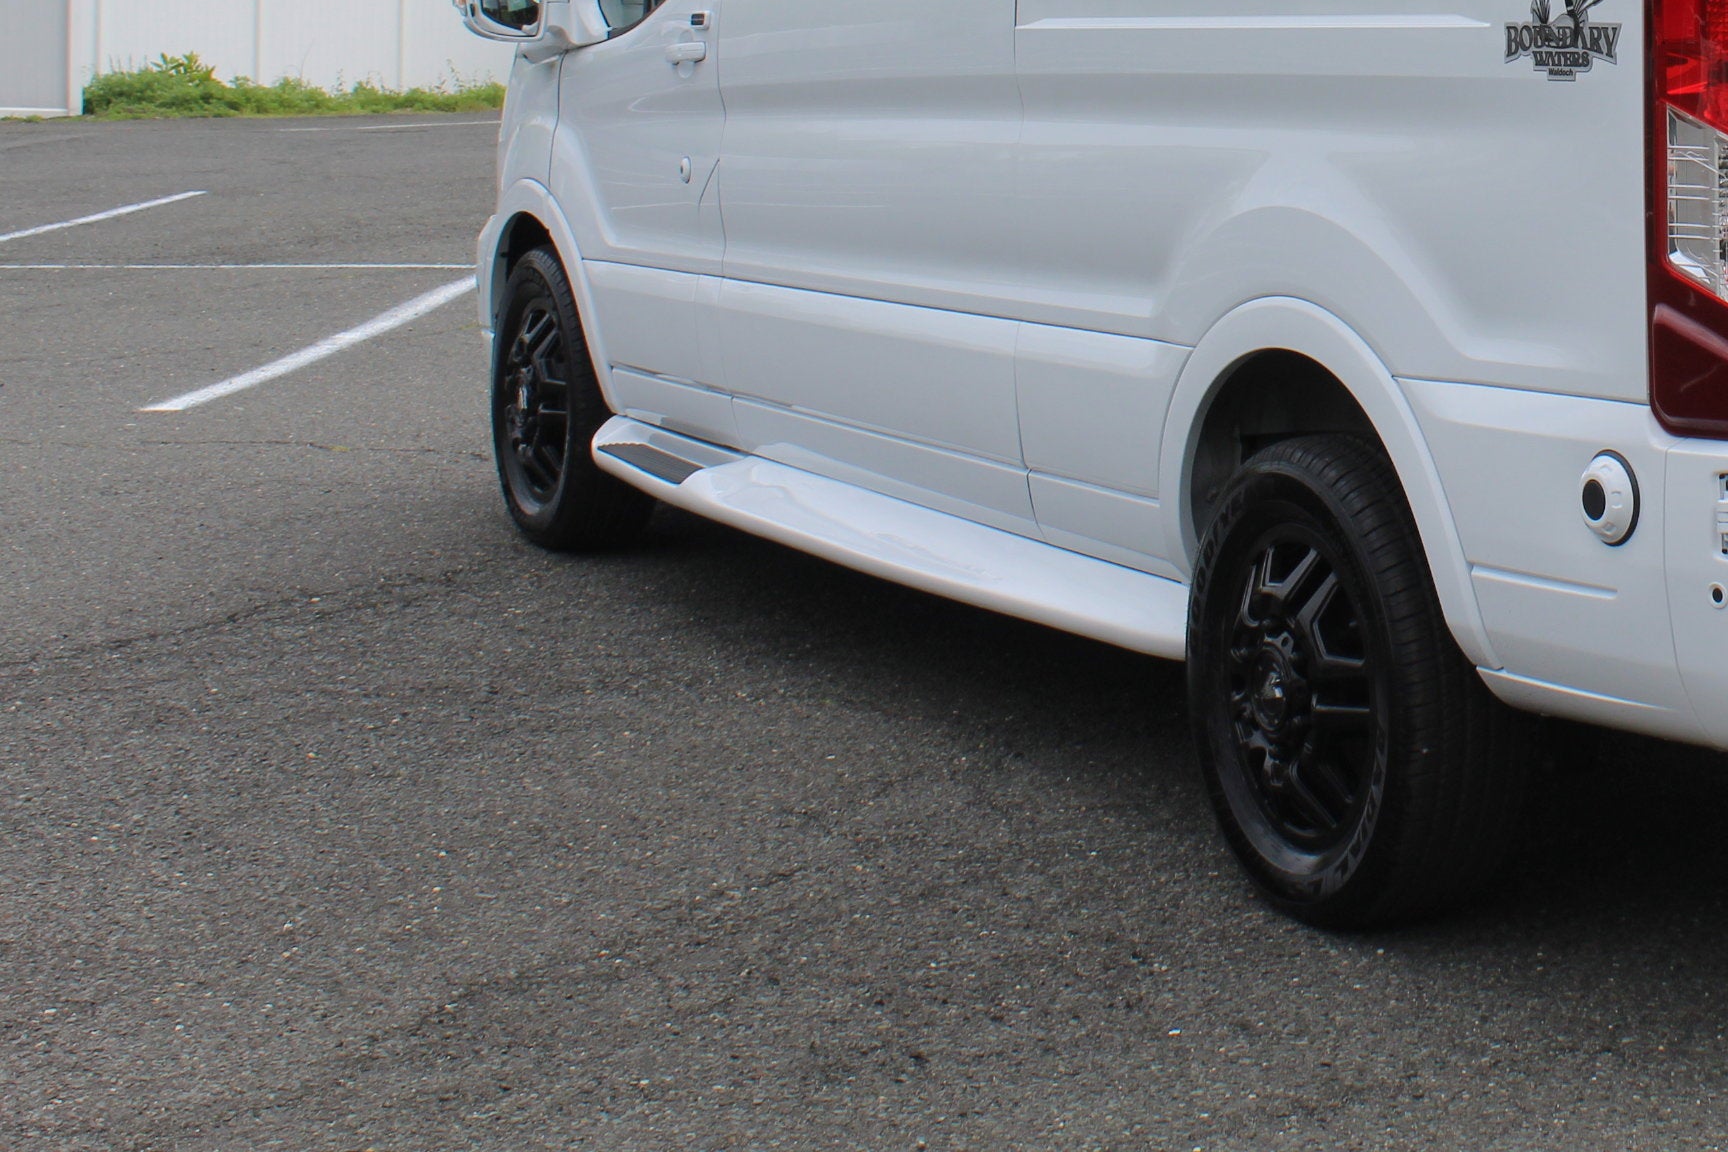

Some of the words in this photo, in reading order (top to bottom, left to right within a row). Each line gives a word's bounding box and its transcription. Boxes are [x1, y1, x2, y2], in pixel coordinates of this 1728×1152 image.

[1506, 24, 1618, 59] BOUNDARY
[1531, 50, 1590, 67] WATERS
[1548, 67, 1574, 77] Waldoch
